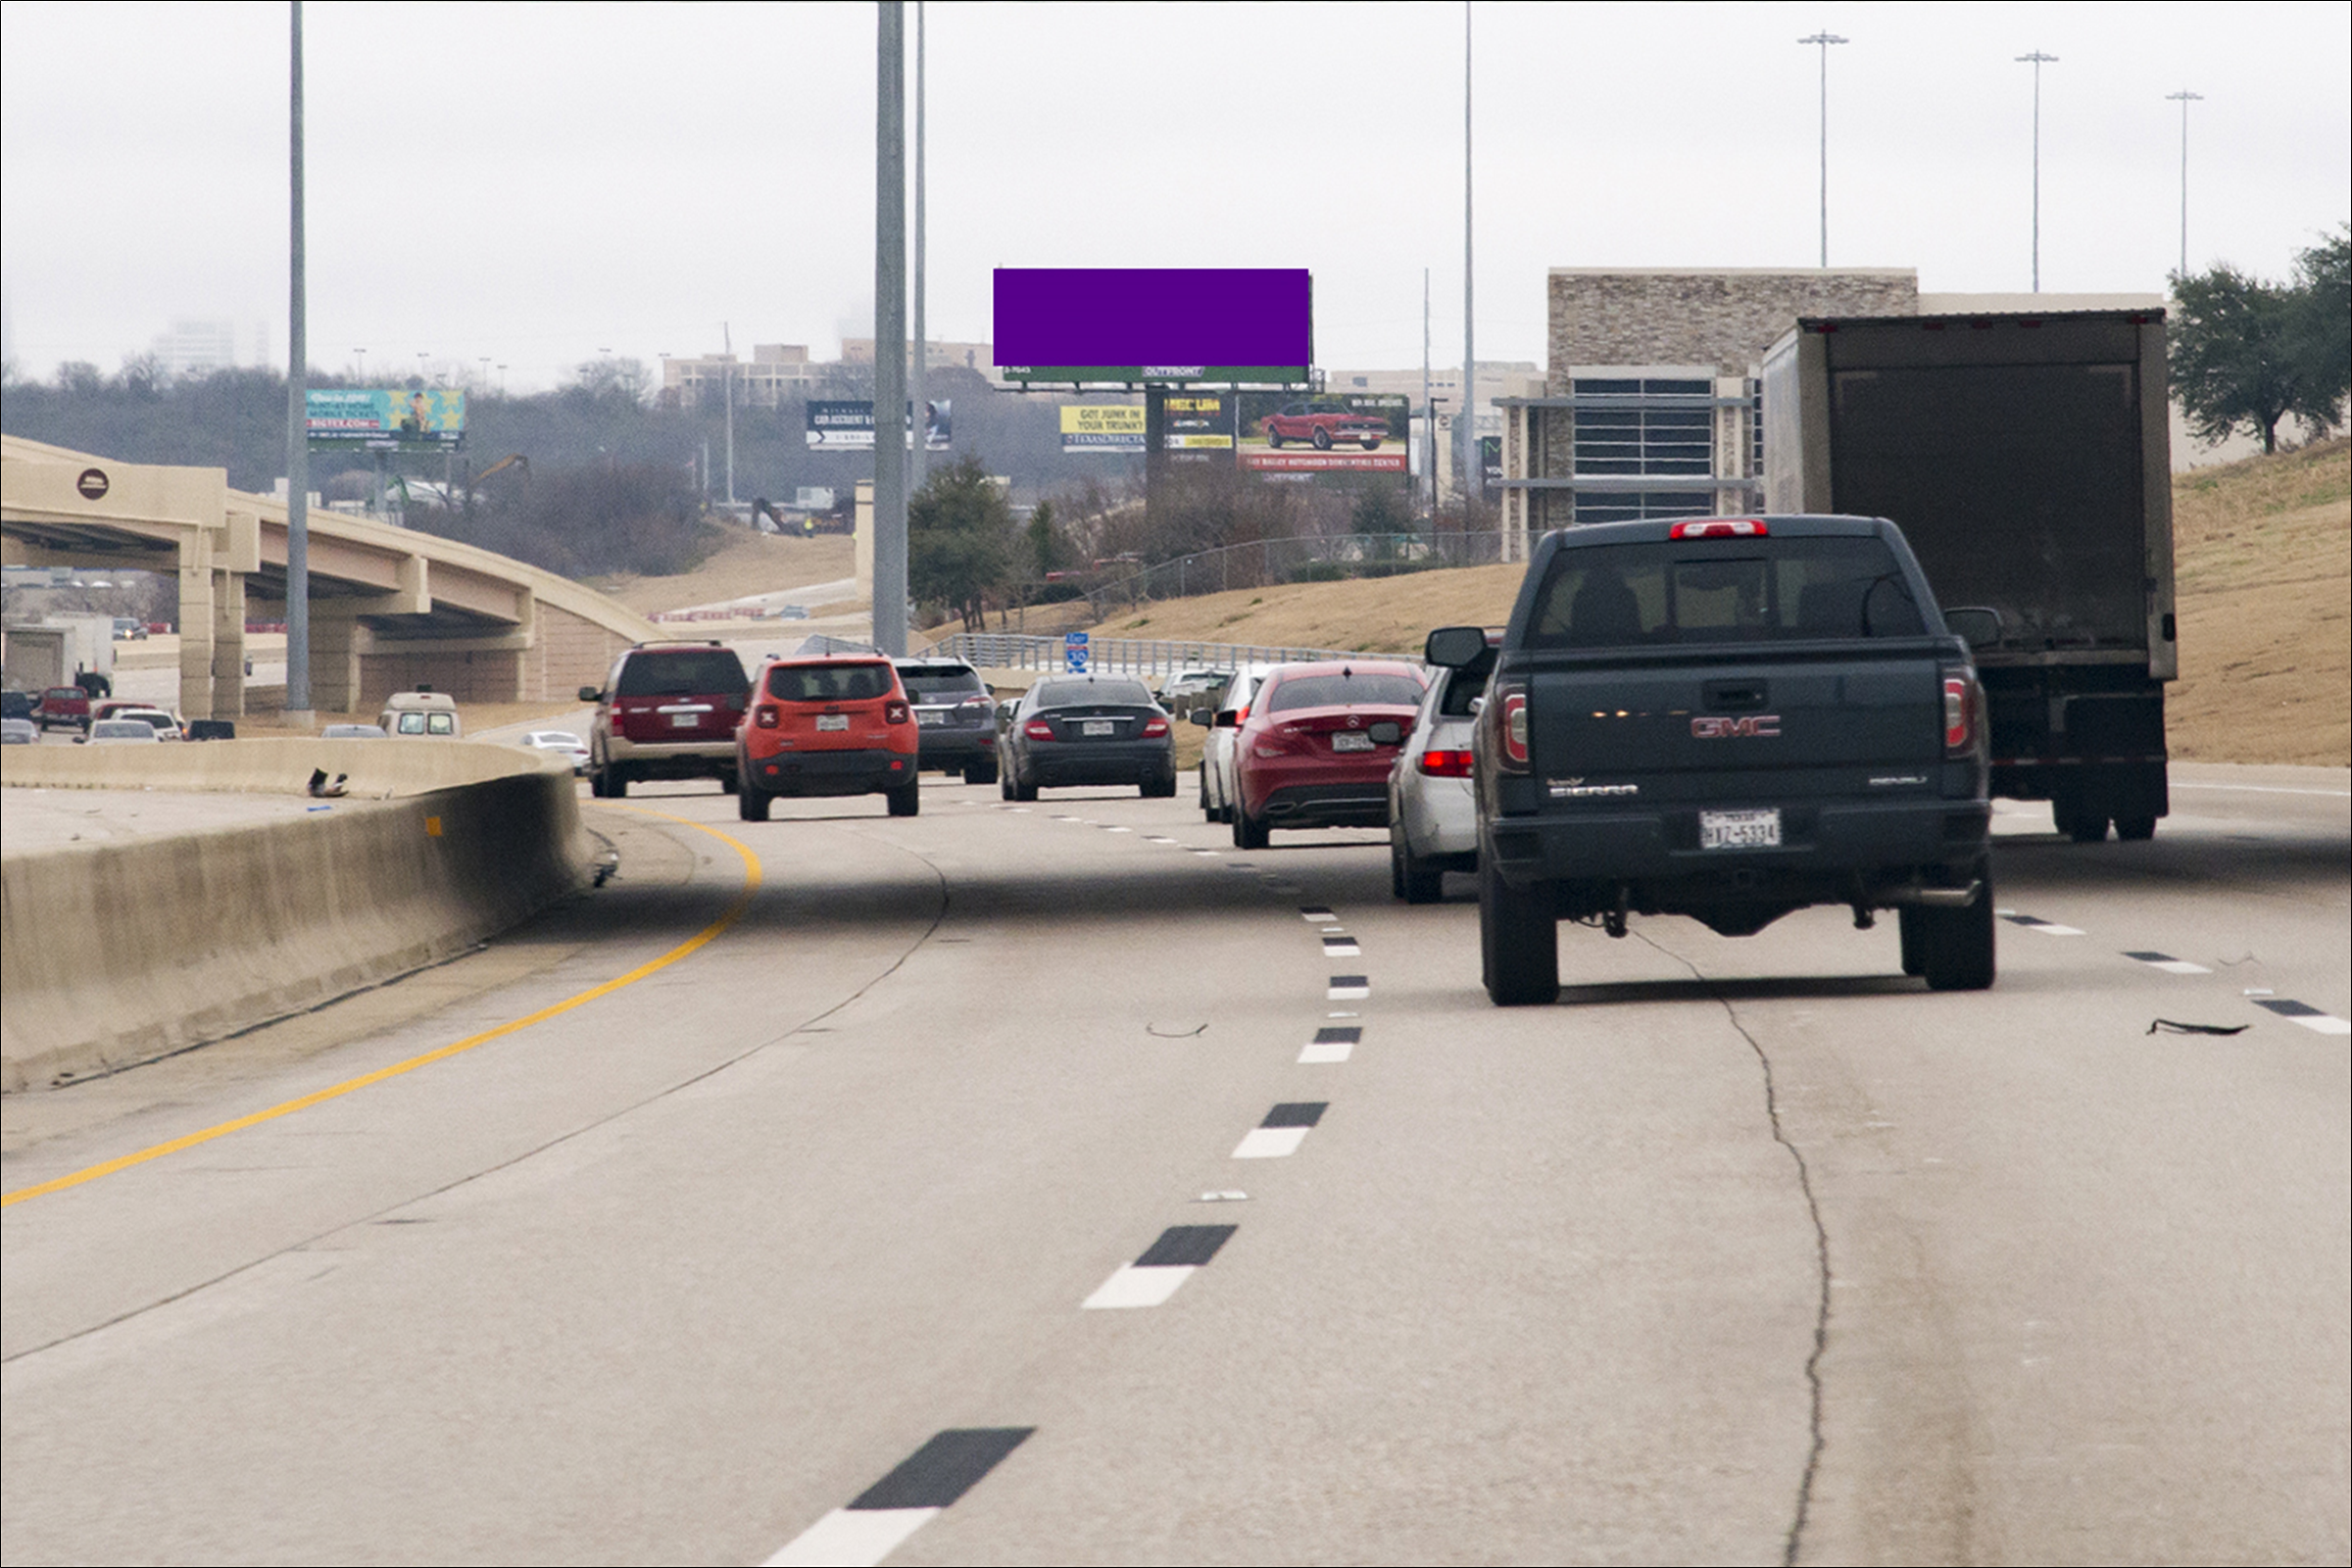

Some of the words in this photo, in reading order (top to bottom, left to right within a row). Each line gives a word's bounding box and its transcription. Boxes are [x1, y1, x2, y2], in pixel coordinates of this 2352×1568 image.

[1144, 367, 1202, 376] OUTFRONT
[1080, 410, 1099, 419] GOT
[1102, 410, 1127, 419] JUNK
[1129, 410, 1140, 419] IN
[1077, 420, 1103, 430] YOUR
[1106, 420, 1144, 430] TRUNK?
[1069, 652, 1086, 662] 30
[1690, 715, 1781, 738] GMC
[1549, 784, 1639, 798] SIERRA
